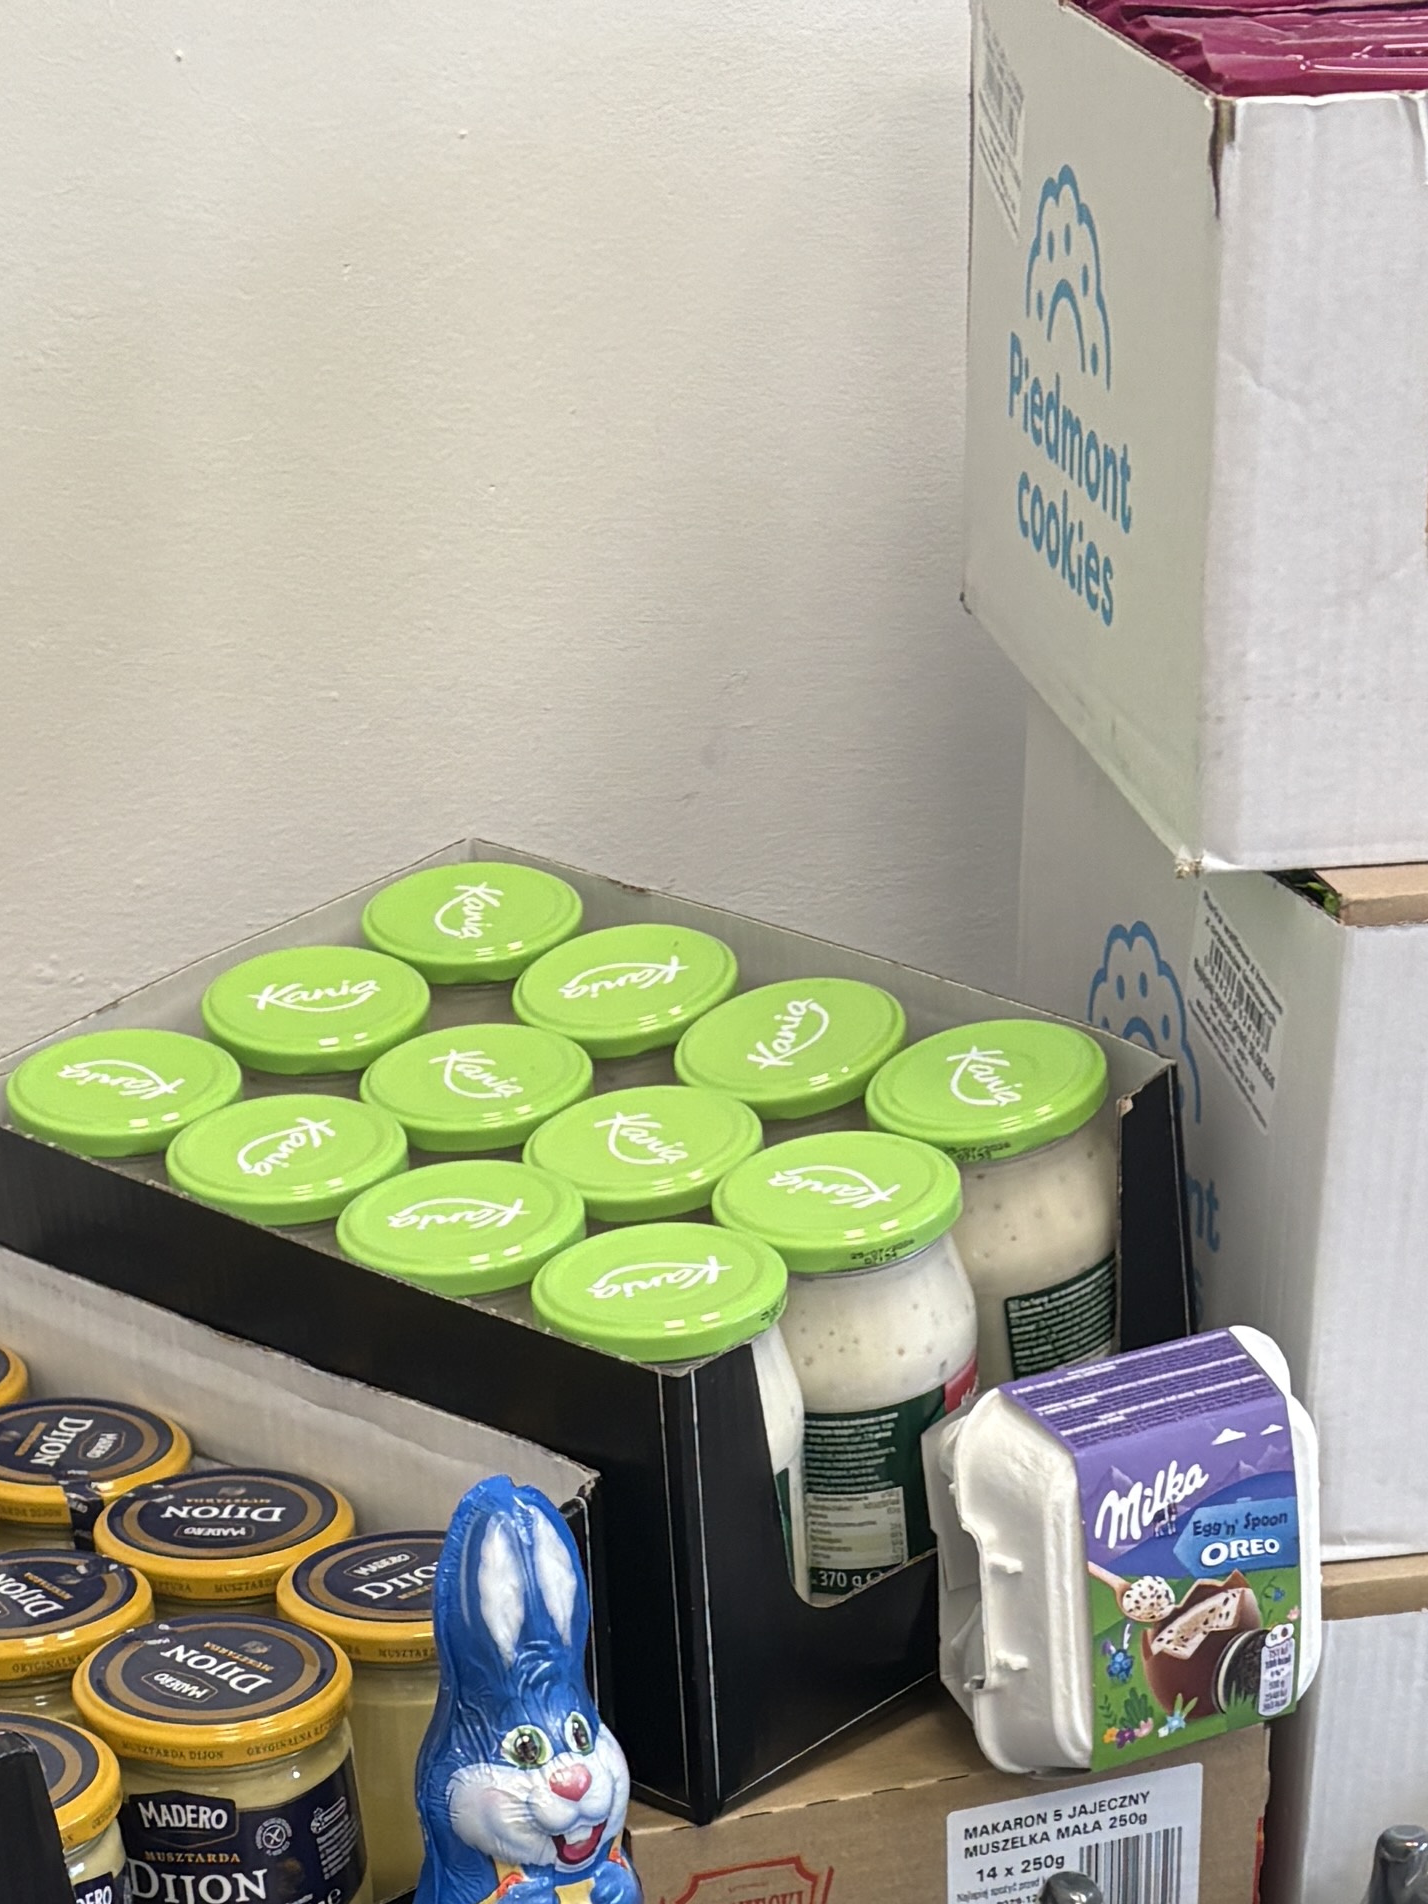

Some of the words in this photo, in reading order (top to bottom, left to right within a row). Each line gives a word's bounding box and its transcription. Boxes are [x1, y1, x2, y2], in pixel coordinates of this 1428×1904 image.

[1009, 332, 1132, 533] Piedmont
[1017, 471, 1114, 626] cookies
[435, 882, 503, 939] Kania
[249, 979, 381, 1012] Kania
[559, 956, 687, 998] Kania
[748, 997, 829, 1070] Kania
[58, 1059, 185, 1099] Kania
[430, 1050, 523, 1099] Kania
[948, 1047, 1021, 1107] Kania
[238, 1117, 335, 1177] Kania
[387, 1198, 530, 1230] Kania
[162, 1504, 287, 1522] DIJON
[1095, 1461, 1209, 1549] Milka
[1244, 1511, 1288, 1531] Spoon
[1200, 1538, 1280, 1567] OREO
[352, 1560, 440, 1600] DIJO
[818, 1570, 847, 1587] 370
[163, 1642, 273, 1695] DIJON
[138, 1801, 228, 1830] MADERO
[964, 1812, 1047, 1840] MAKARON
[1054, 1809, 1062, 1821] 5
[1068, 1790, 1150, 1819] JAJECZNY
[964, 1831, 1050, 1859] MUSZELKA
[1056, 1820, 1102, 1839] MAŁA
[1109, 1812, 1148, 1830] 250g
[144, 1851, 241, 1863] MUSZTARDA
[976, 1866, 997, 1882] 14
[1004, 1866, 1013, 1877] x
[1021, 1855, 1065, 1873] 250g
